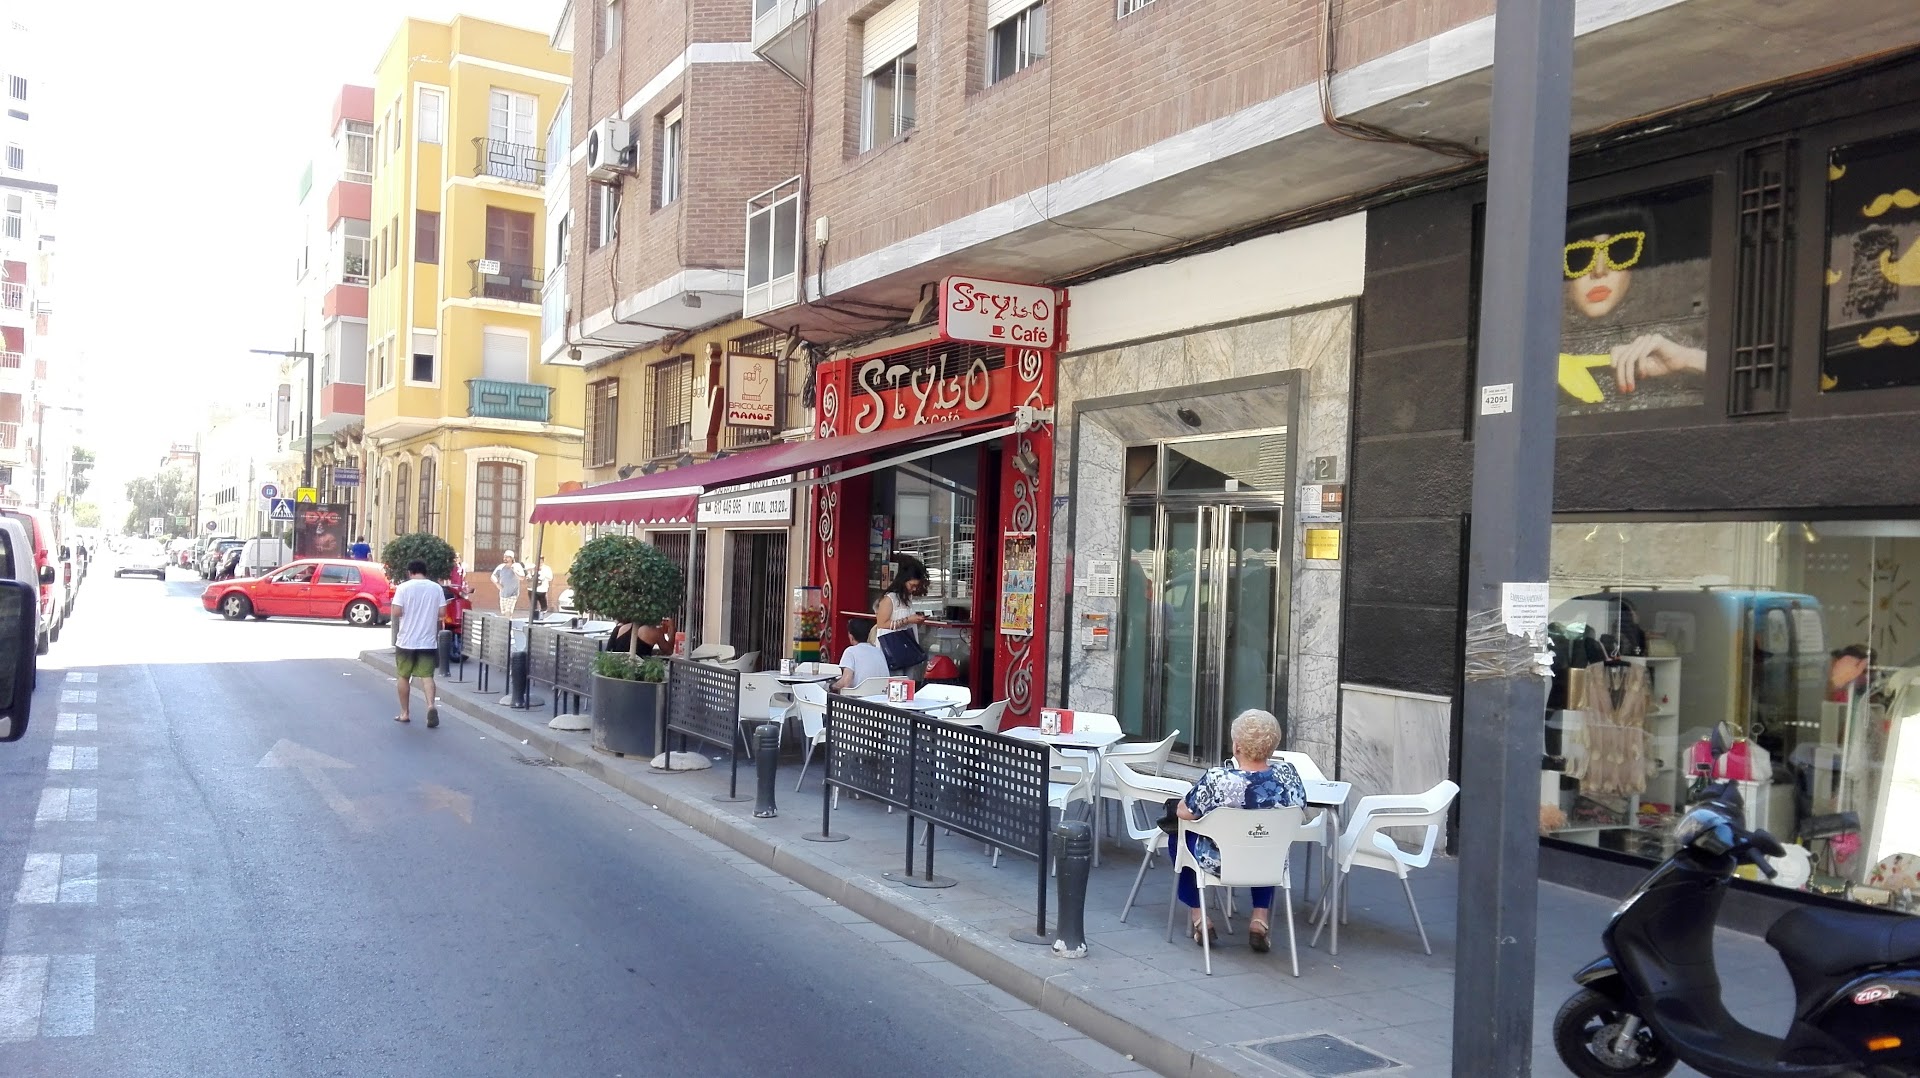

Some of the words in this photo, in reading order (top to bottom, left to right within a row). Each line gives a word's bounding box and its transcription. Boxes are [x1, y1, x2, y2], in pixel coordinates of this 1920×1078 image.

[952, 282, 1049, 321] STYLO
[1011, 324, 1048, 343] Café
[1485, 395, 1508, 404] 42091
[729, 401, 774, 412] BRICOLAGE
[729, 411, 773, 421] MANOS
[1319, 458, 1329, 478] 2
[752, 500, 767, 513] LOCAL
[1857, 989, 1882, 1002] ZIP
